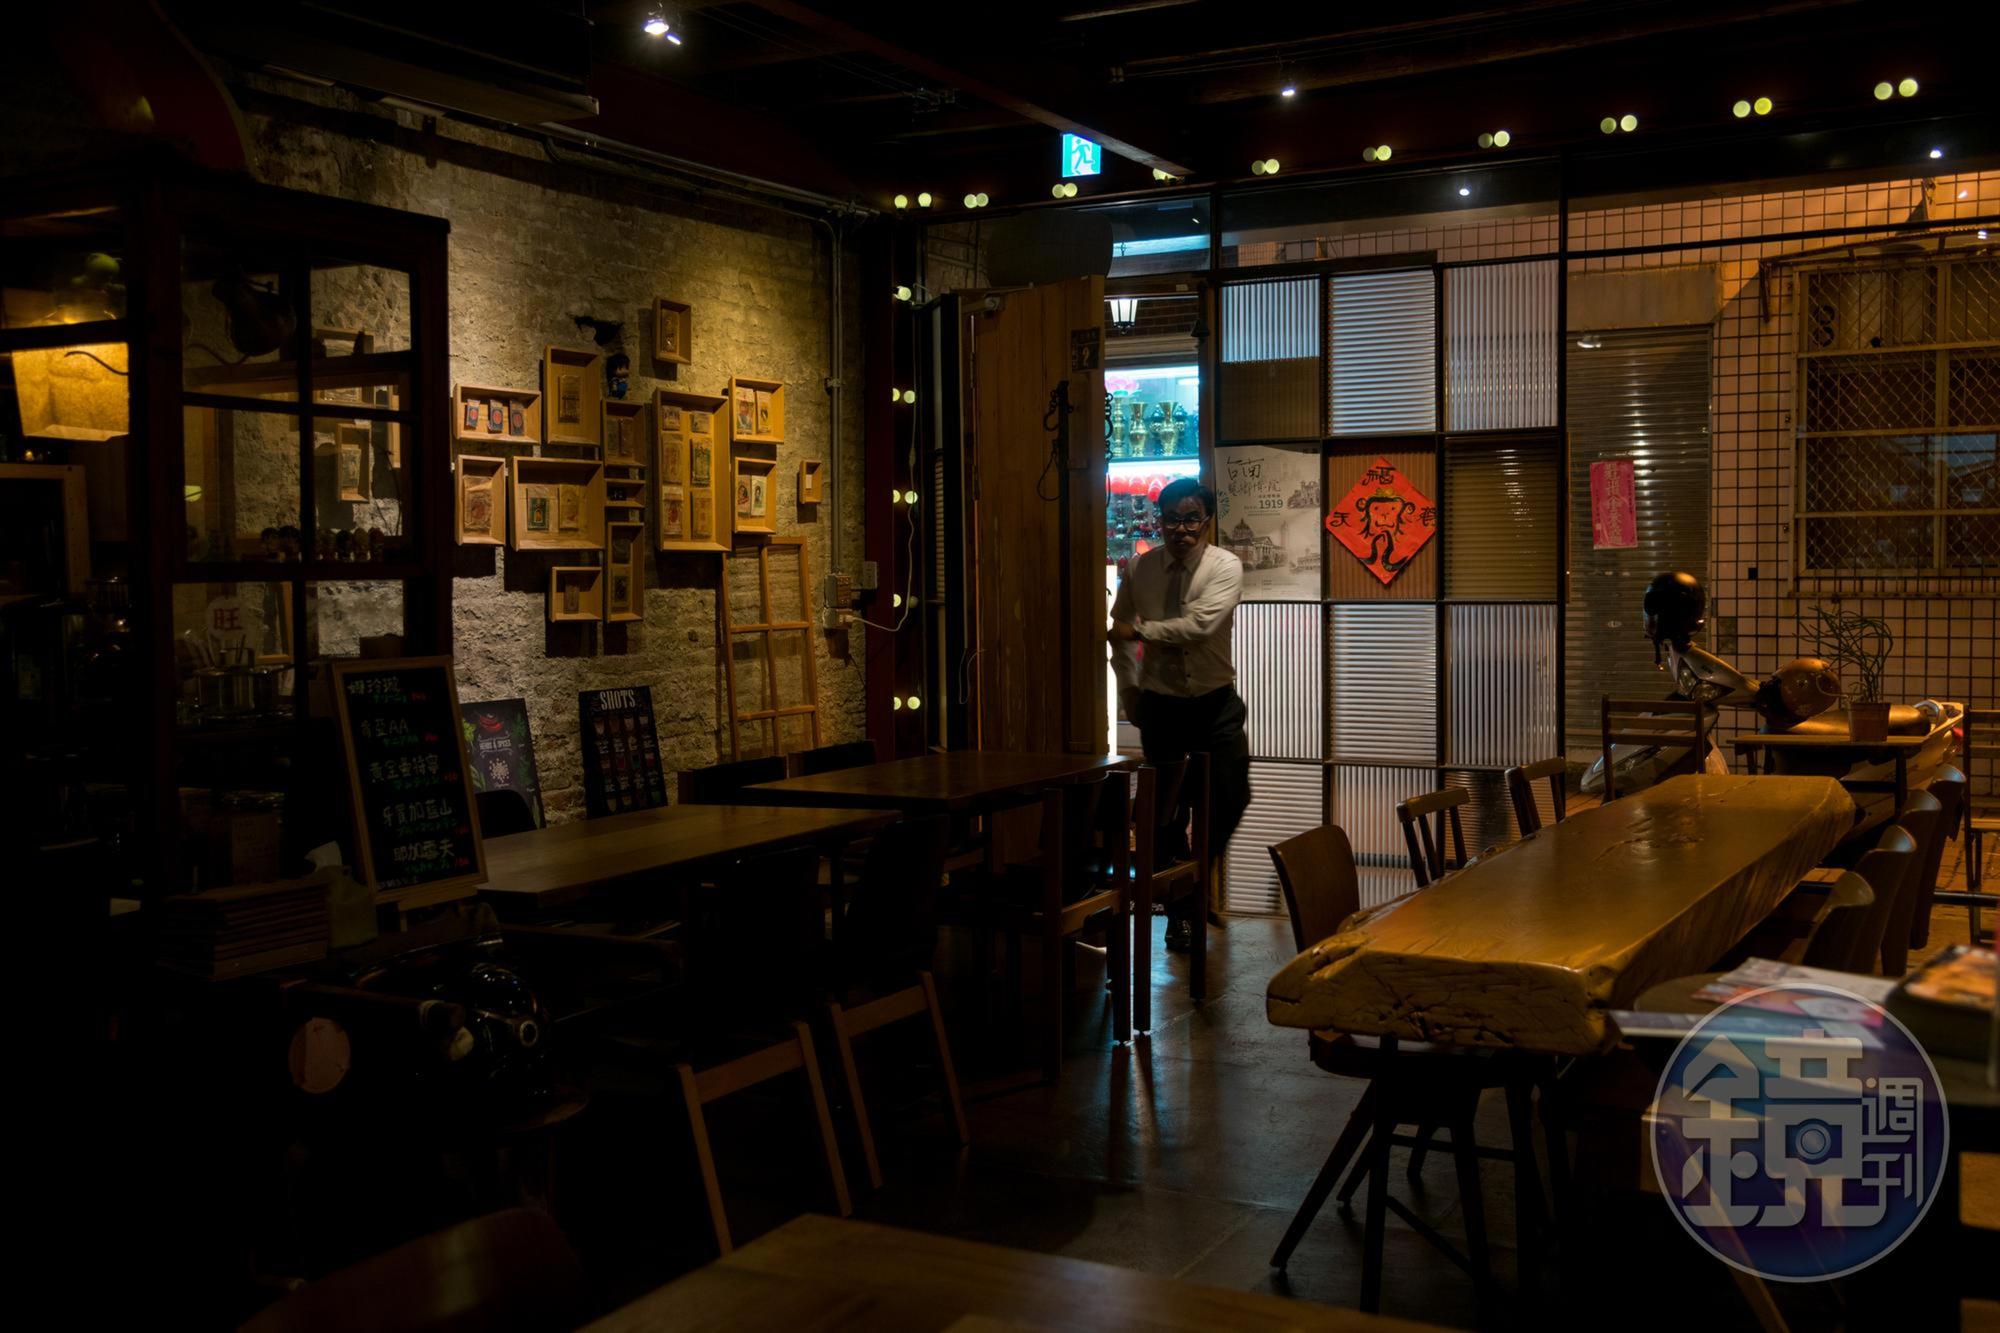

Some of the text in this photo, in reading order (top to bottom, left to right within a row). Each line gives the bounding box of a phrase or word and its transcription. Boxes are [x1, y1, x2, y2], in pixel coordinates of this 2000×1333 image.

[1259, 498, 1284, 510] 1919
[1330, 511, 1351, 527] 天
[213, 605, 243, 631] 旺
[599, 687, 637, 711] SHOTS
